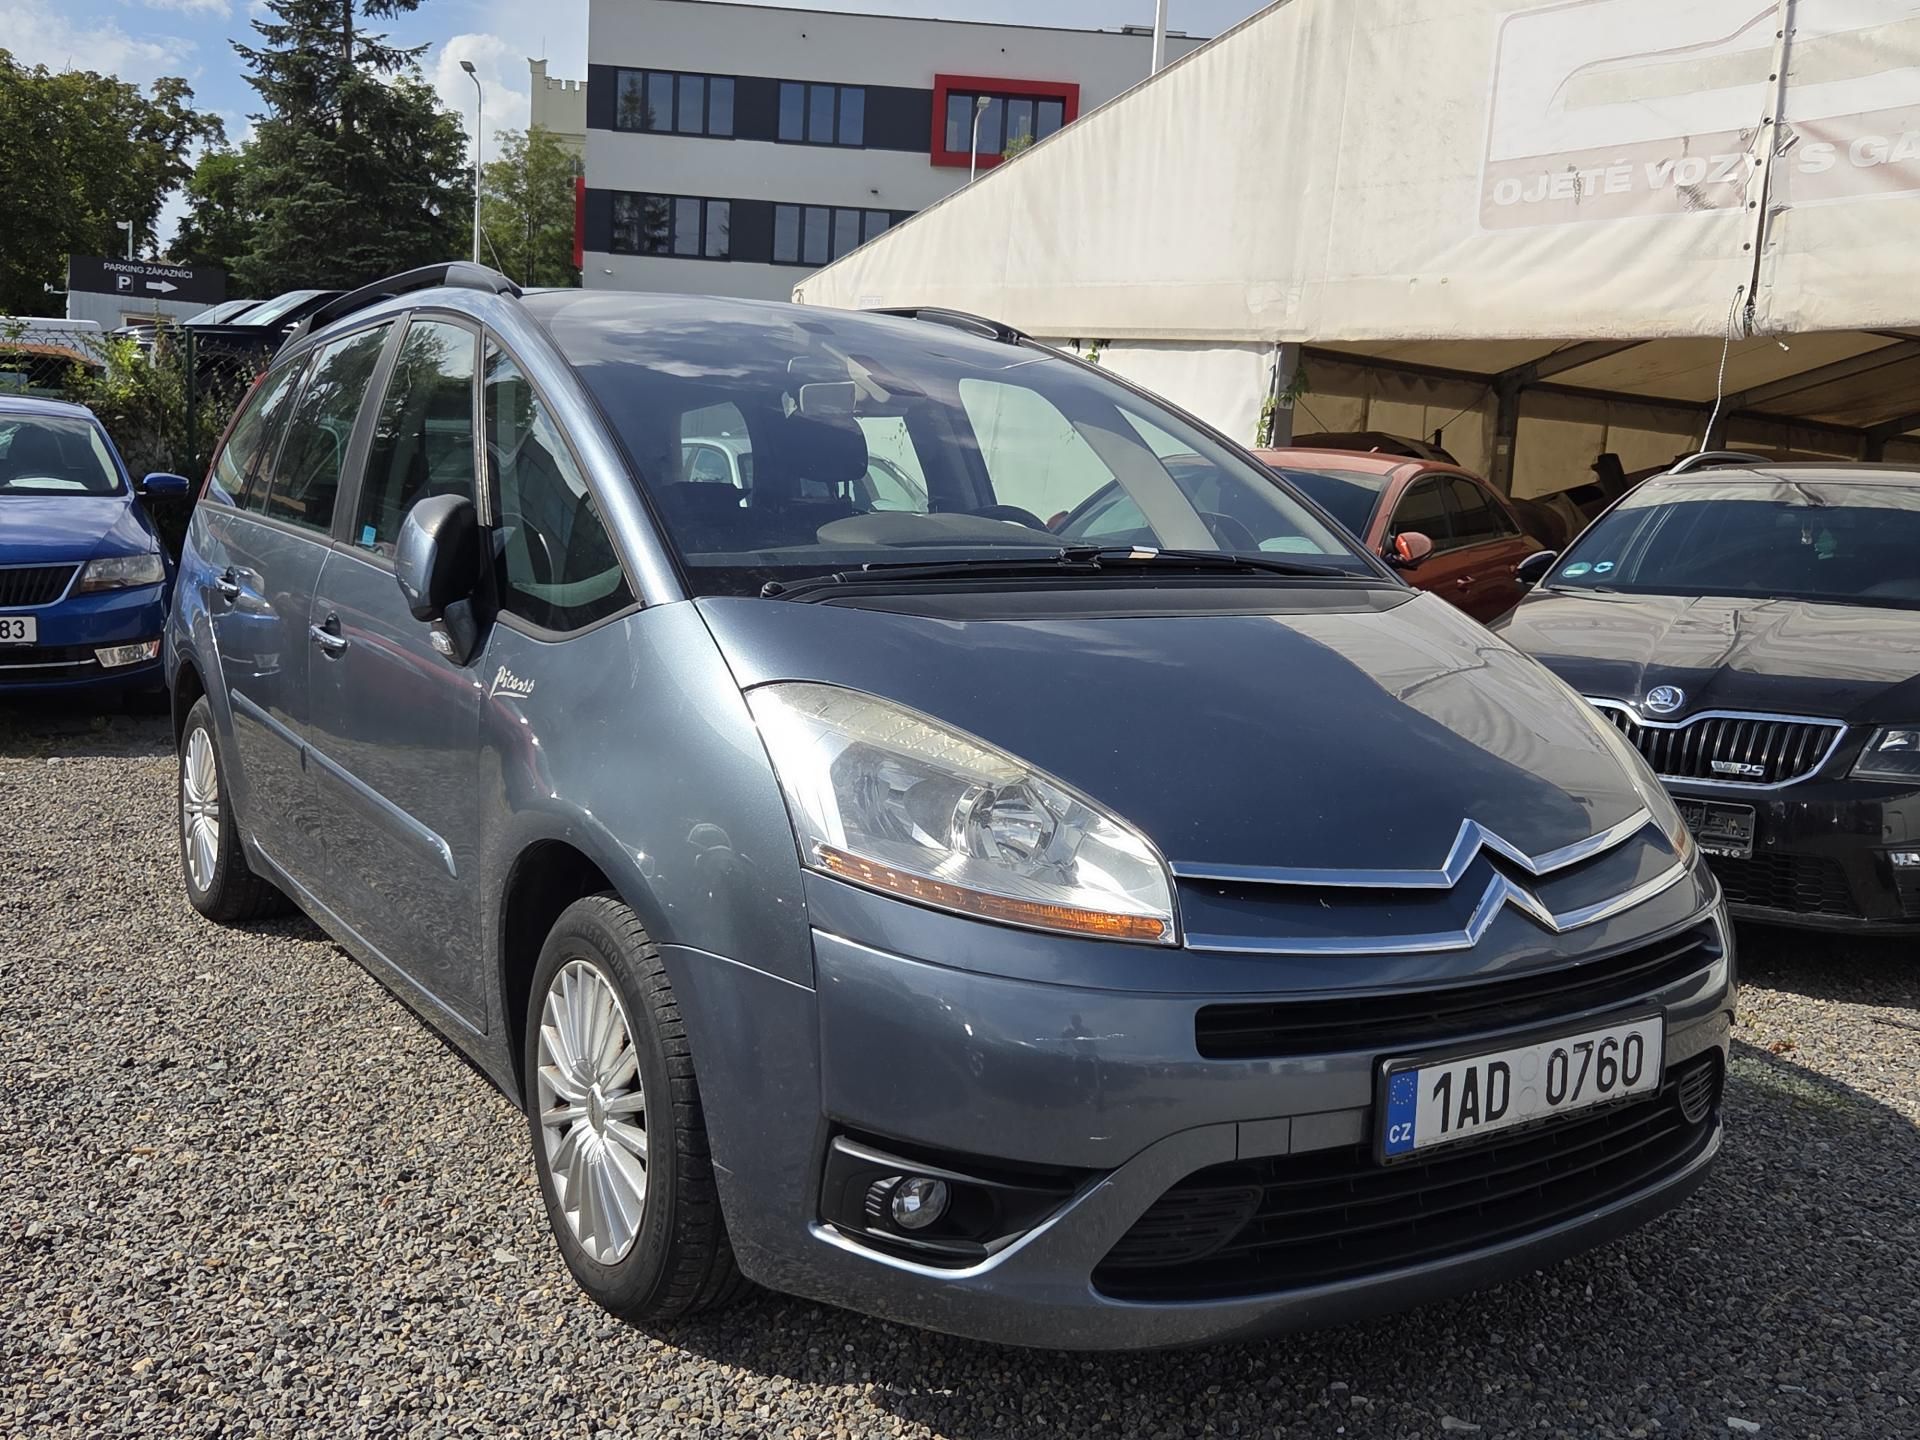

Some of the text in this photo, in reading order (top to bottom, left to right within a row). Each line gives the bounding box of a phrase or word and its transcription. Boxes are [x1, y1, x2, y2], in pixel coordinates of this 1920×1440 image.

[1493, 159, 1633, 205] OJETÉ
[1800, 142, 1836, 174] S
[103, 262, 193, 279] PARKING ZÁKAZNÍCI
[118, 276, 131, 289] P
[0, 620, 25, 639] 83
[489, 665, 535, 700] Picasso
[1432, 1030, 1644, 1134] 1AD 0760
[1388, 1122, 1412, 1144] CZ
